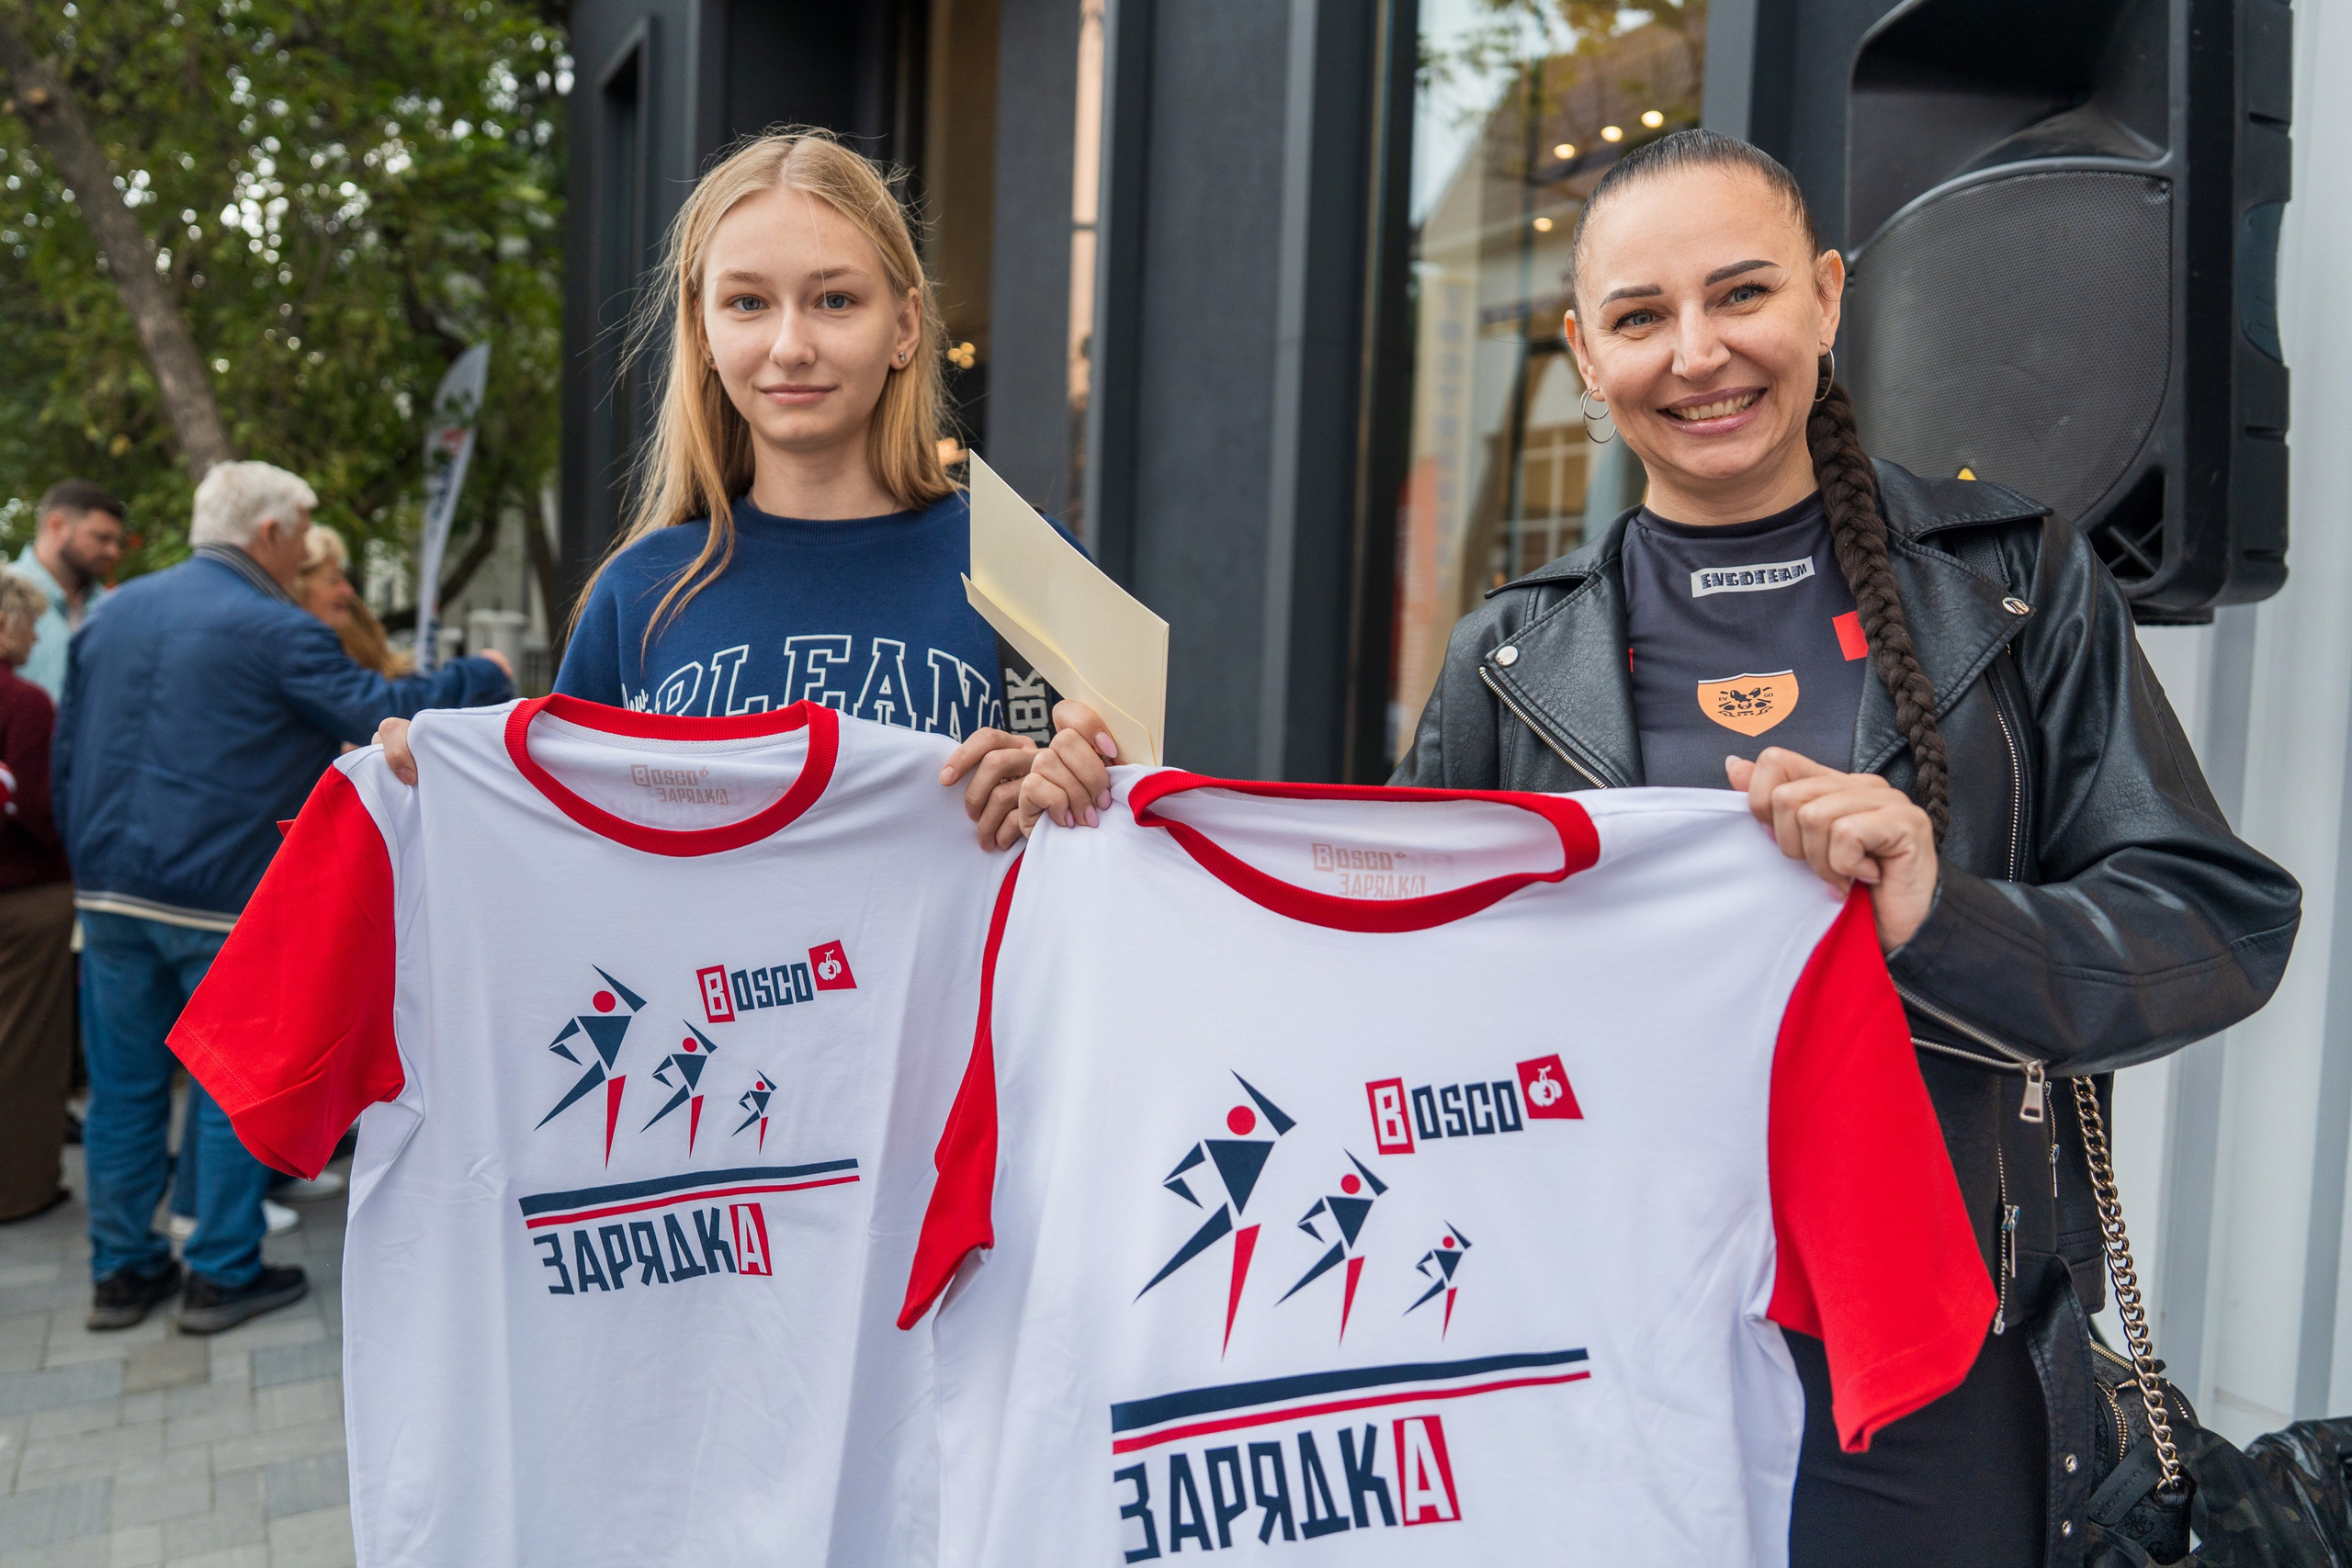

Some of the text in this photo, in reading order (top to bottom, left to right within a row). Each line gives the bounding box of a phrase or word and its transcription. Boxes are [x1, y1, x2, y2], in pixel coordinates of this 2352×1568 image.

[646, 634, 1007, 741] RLEAN
[657, 787, 729, 806] ЗАРЯДКА
[1338, 873, 1427, 899] ЗАРЯДКА
[695, 962, 815, 1024] BOSCO
[1365, 1077, 1524, 1156] BOSCO
[532, 1201, 773, 1296] ЗАРЯДКА
[1113, 1413, 1463, 1565] ЗАРЯДКА
